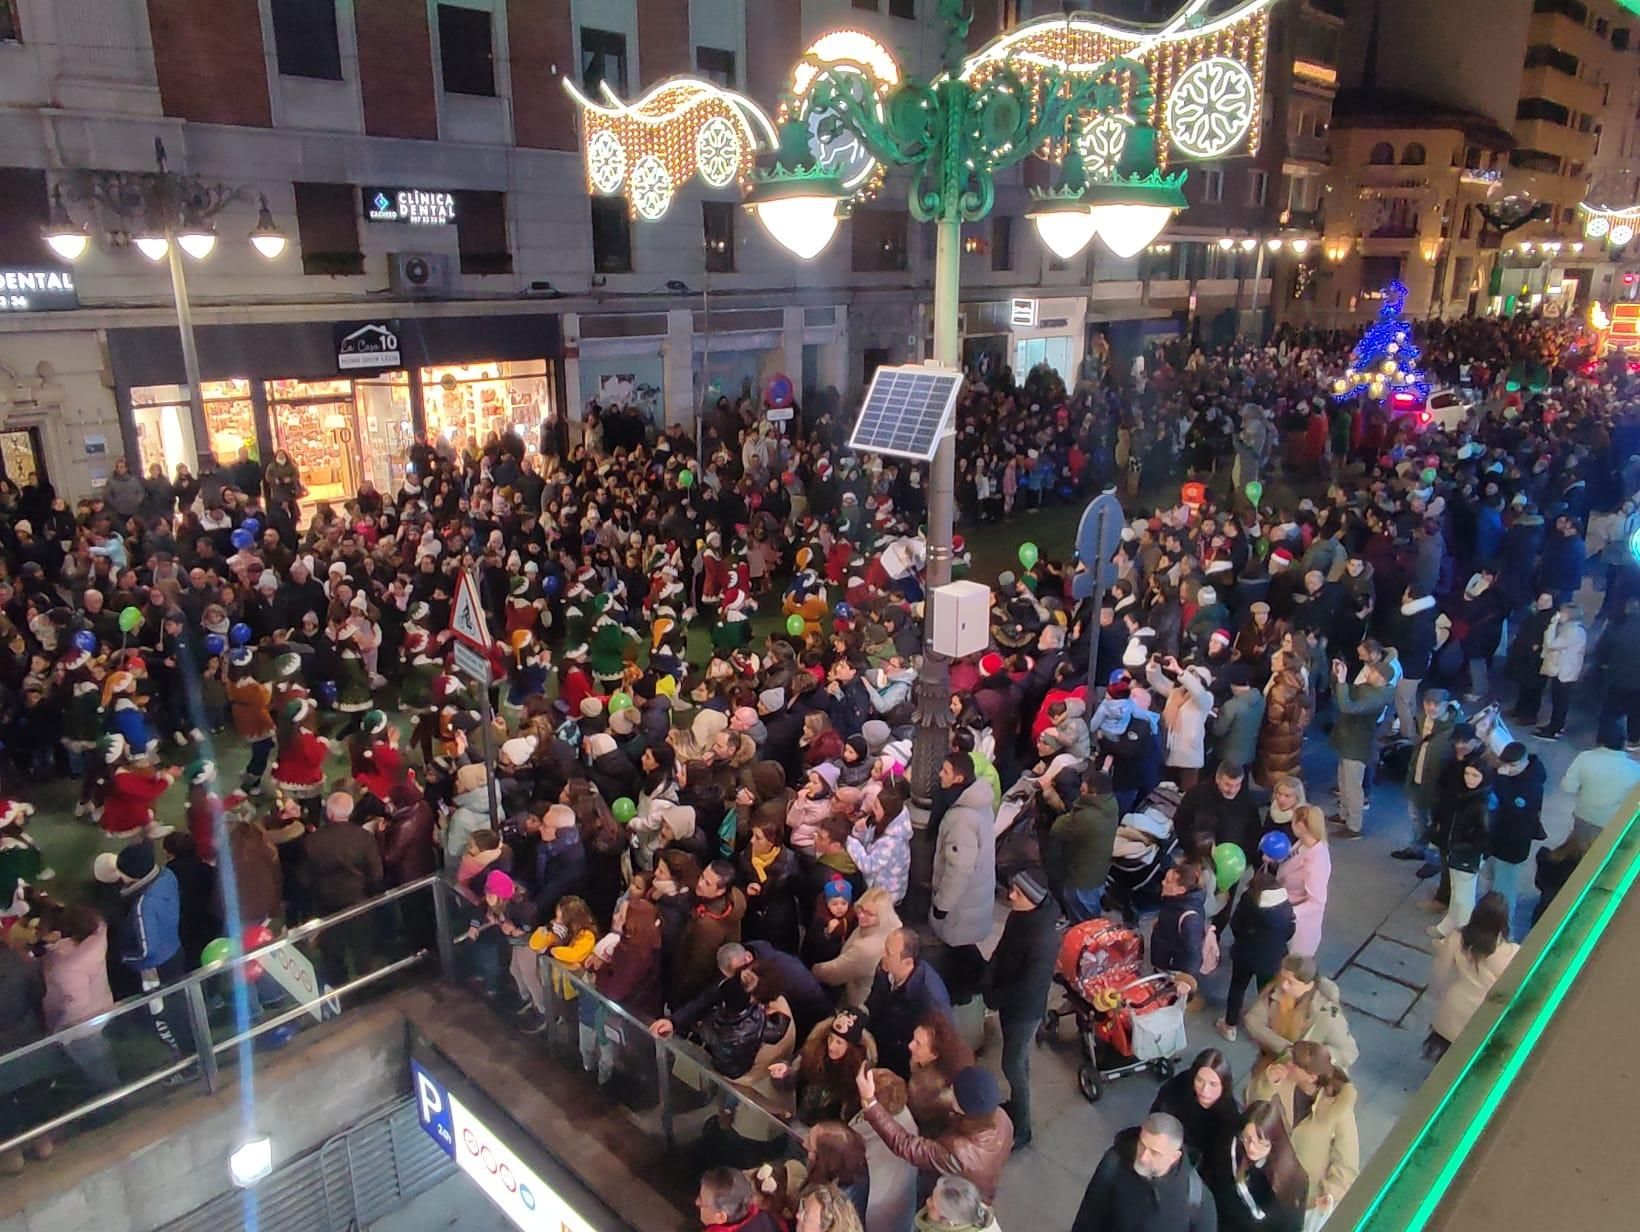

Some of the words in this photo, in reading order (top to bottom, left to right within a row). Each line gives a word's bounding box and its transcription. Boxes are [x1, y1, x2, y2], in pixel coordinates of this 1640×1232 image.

[398, 190, 454, 206] CLÍNICA
[400, 204, 456, 218] DENTAL
[379, 335, 398, 350] 10
[418, 1071, 442, 1123] P
